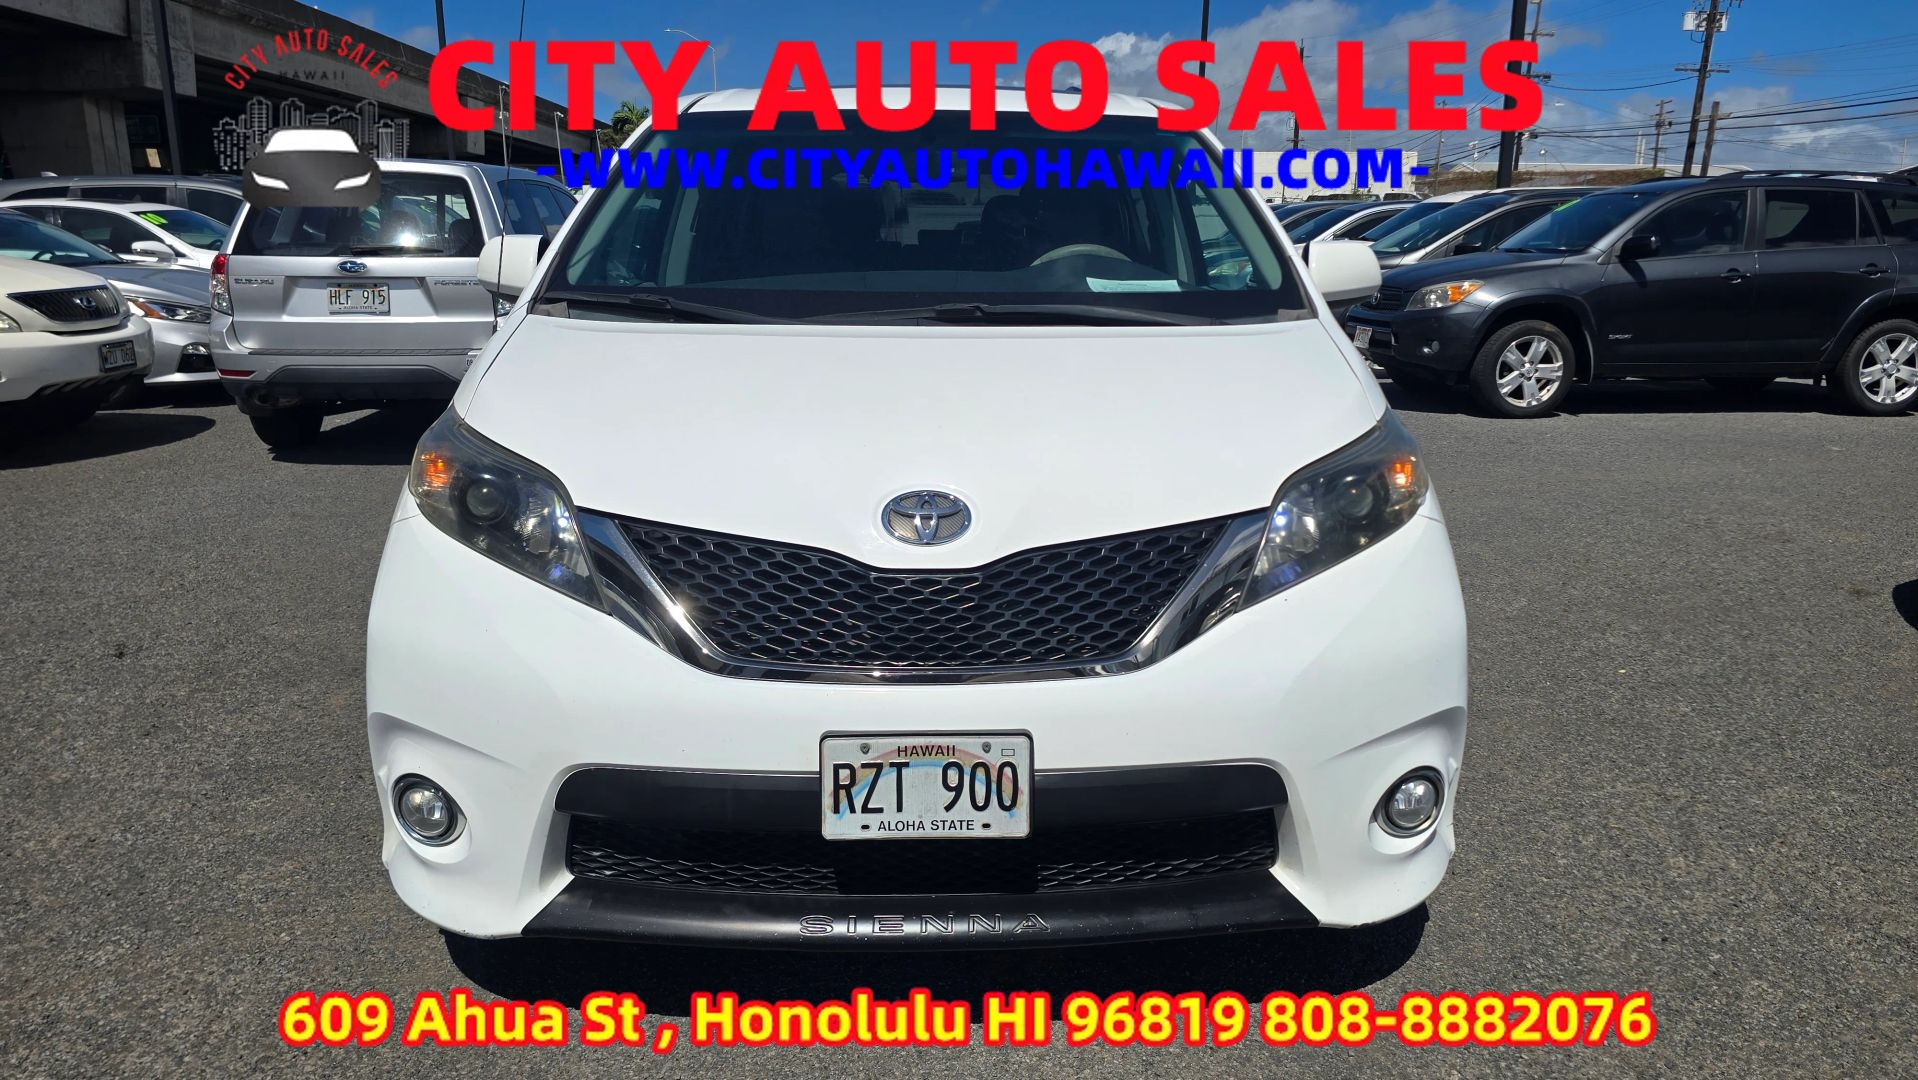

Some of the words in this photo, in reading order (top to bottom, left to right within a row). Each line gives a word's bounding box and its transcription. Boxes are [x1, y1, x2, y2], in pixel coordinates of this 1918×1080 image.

[329, 289, 353, 305] HLF
[362, 289, 386, 305] 915
[897, 745, 956, 757] HAWAII
[832, 761, 910, 814] RZT
[941, 760, 1019, 813] 900
[877, 820, 926, 832] ALOHA
[930, 819, 975, 831] STATE
[799, 914, 1050, 936] SIENNA
